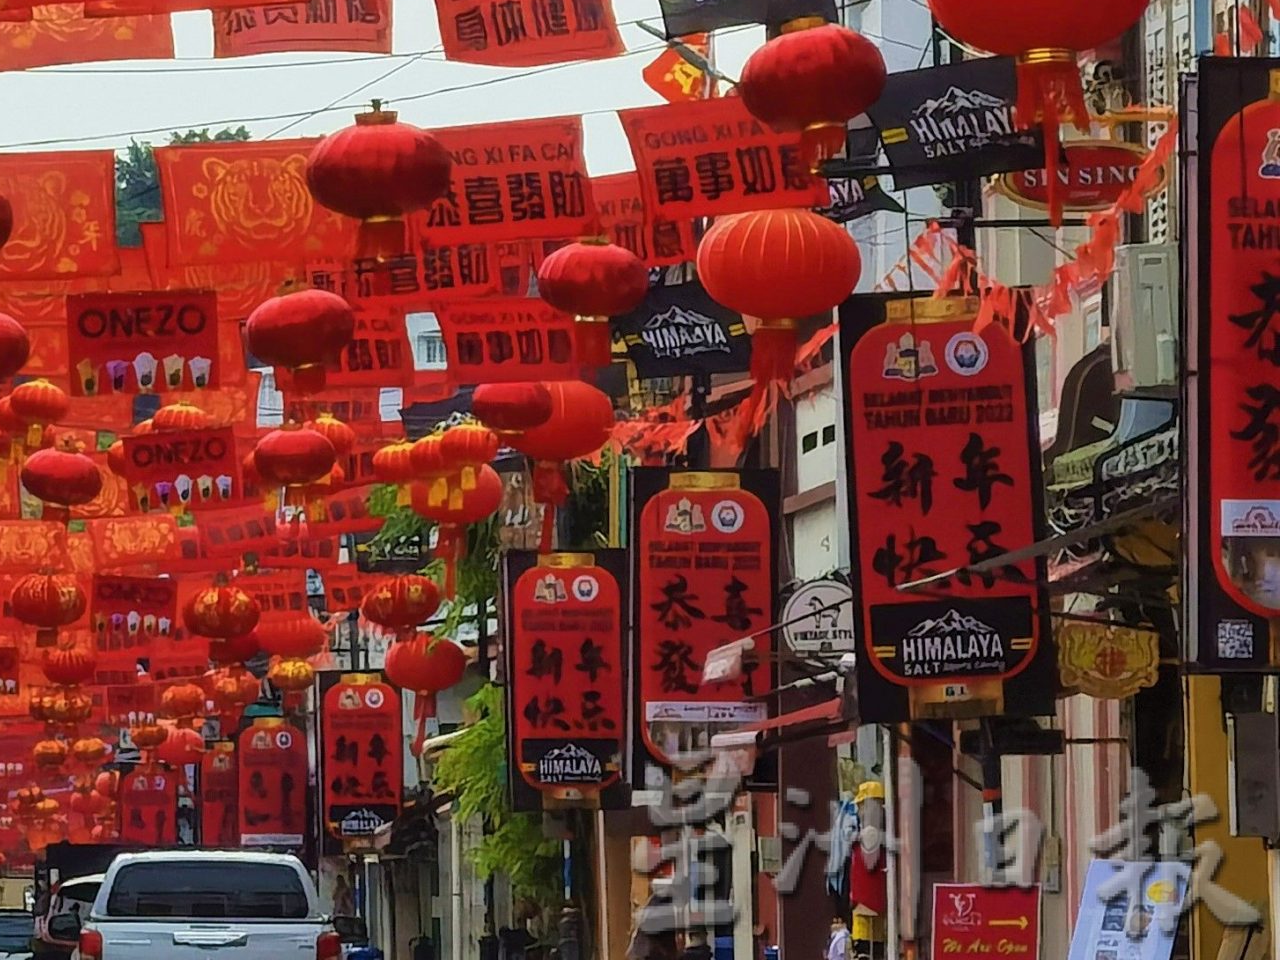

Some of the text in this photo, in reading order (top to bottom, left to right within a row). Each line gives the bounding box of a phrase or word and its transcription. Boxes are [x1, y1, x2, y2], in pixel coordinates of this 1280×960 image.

[483, 145, 504, 163] XI
[509, 145, 537, 163] FA
[541, 142, 576, 161] CAI
[925, 138, 966, 159] SALT
[78, 304, 207, 338] ONEZO
[132, 437, 227, 468] ONEZO
[902, 633, 1004, 661] HIMALAYA
[904, 663, 941, 676] SALT
[539, 759, 601, 775] HIMALAYA
